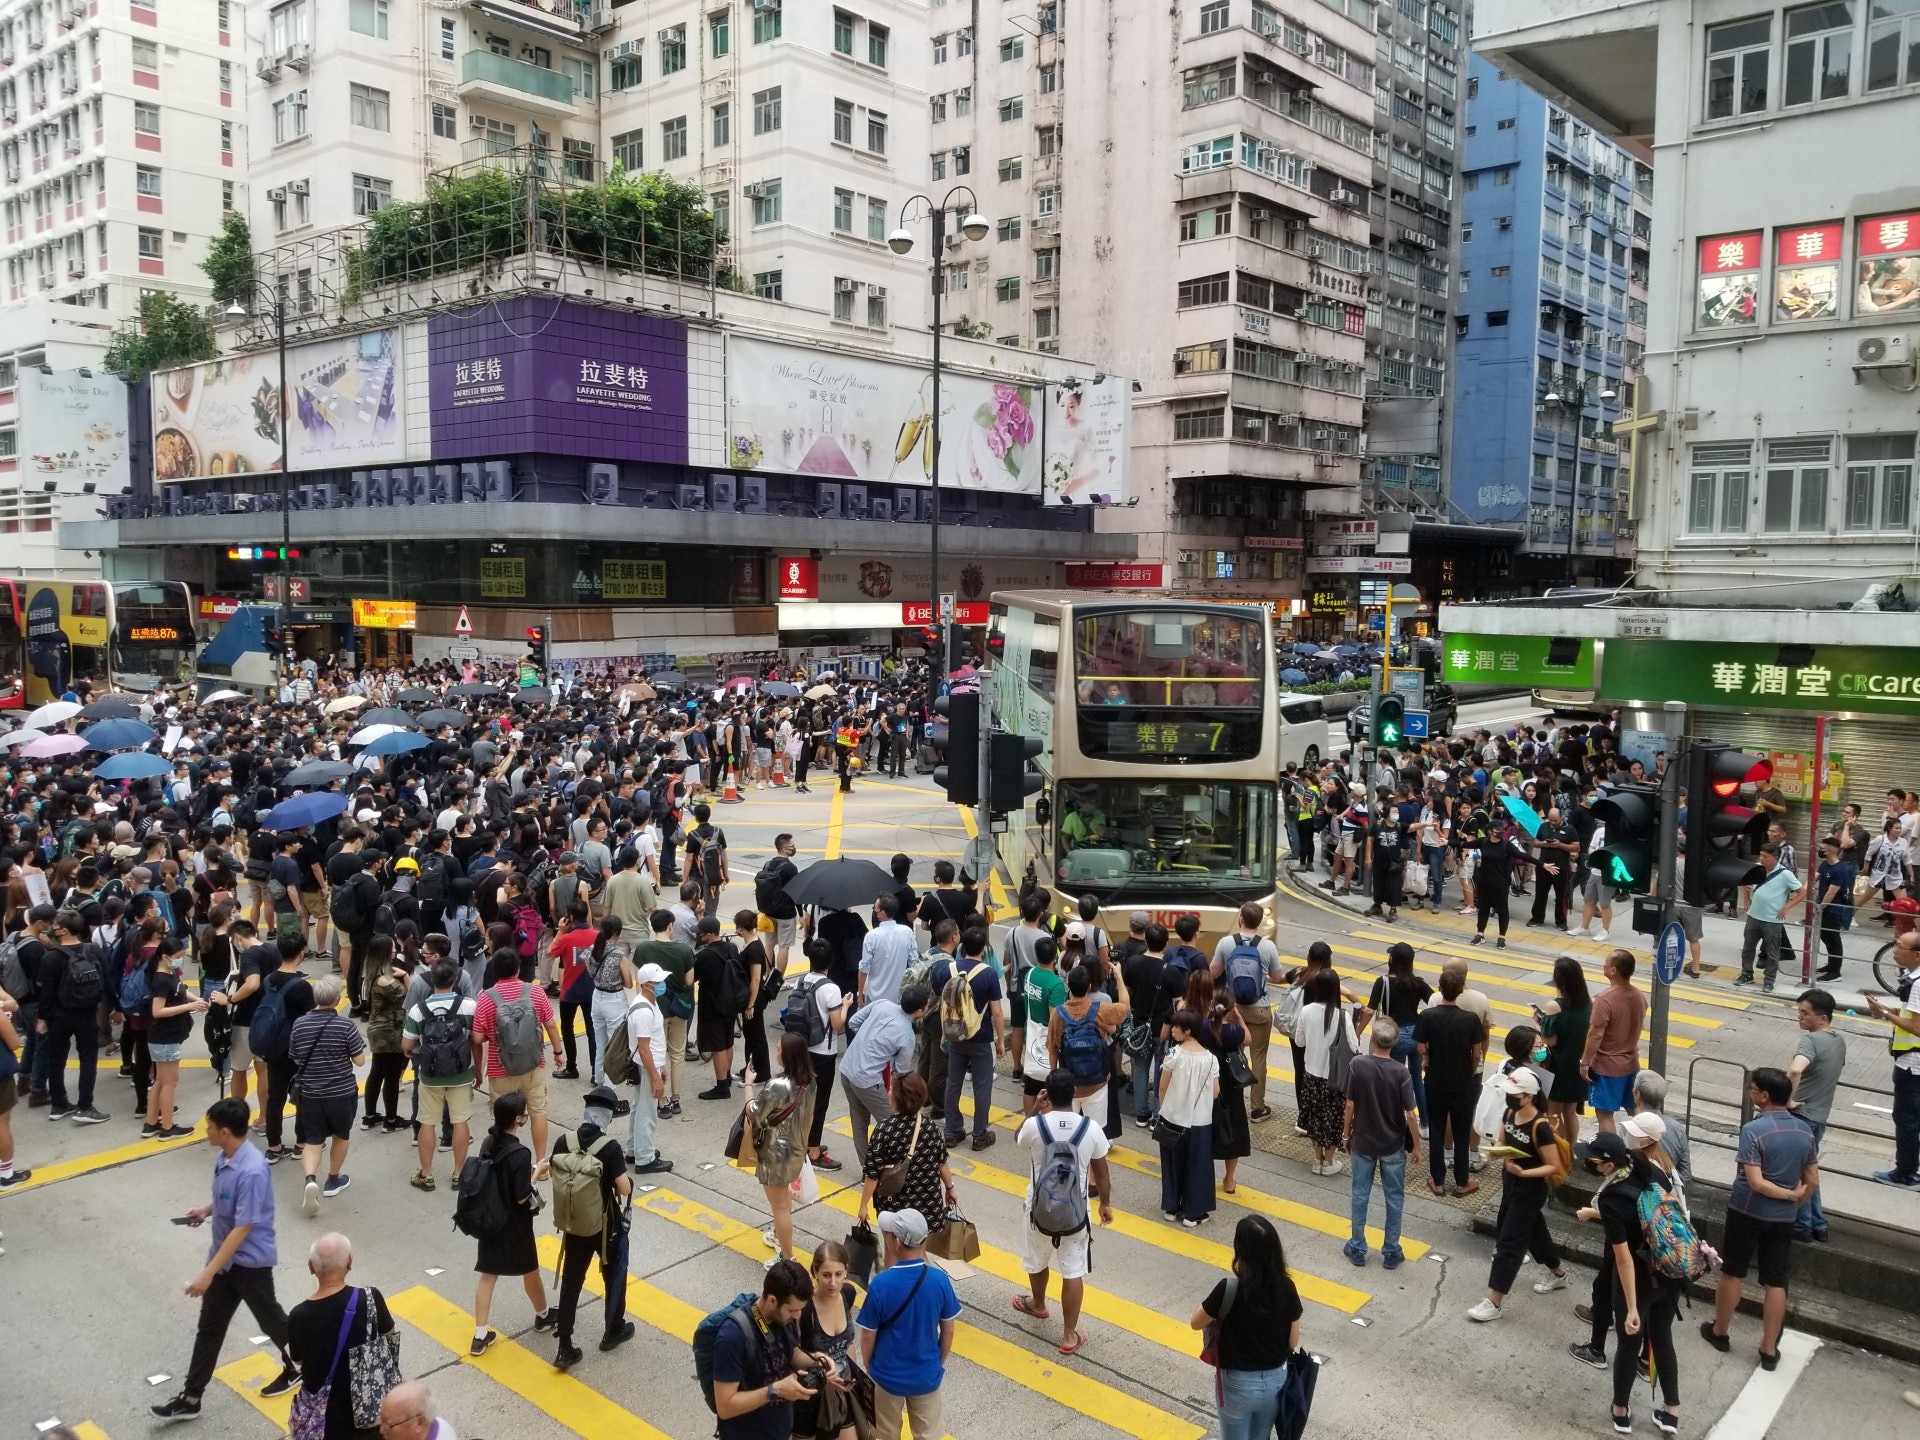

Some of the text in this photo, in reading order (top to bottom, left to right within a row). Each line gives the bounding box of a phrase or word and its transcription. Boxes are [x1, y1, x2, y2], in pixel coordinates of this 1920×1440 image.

[455, 358, 502, 385] 拉斐特
[580, 359, 648, 389] 拉斐特
[772, 361, 879, 391] Where Love Blossoms
[40, 383, 110, 398] Enjoy Your Day
[454, 384, 505, 398] LAFAYETTE WEDDING
[577, 386, 652, 402] LAFAYETTE WEDDING
[604, 583, 620, 594] 2780
[623, 583, 639, 594] 1201
[160, 628, 177, 639] 87D
[1624, 626, 1662, 635] 窩打老道
[1450, 649, 1520, 671] 華潤堂
[1712, 661, 1832, 697] 華潤堂
[1136, 722, 1225, 751] 樂富 7
